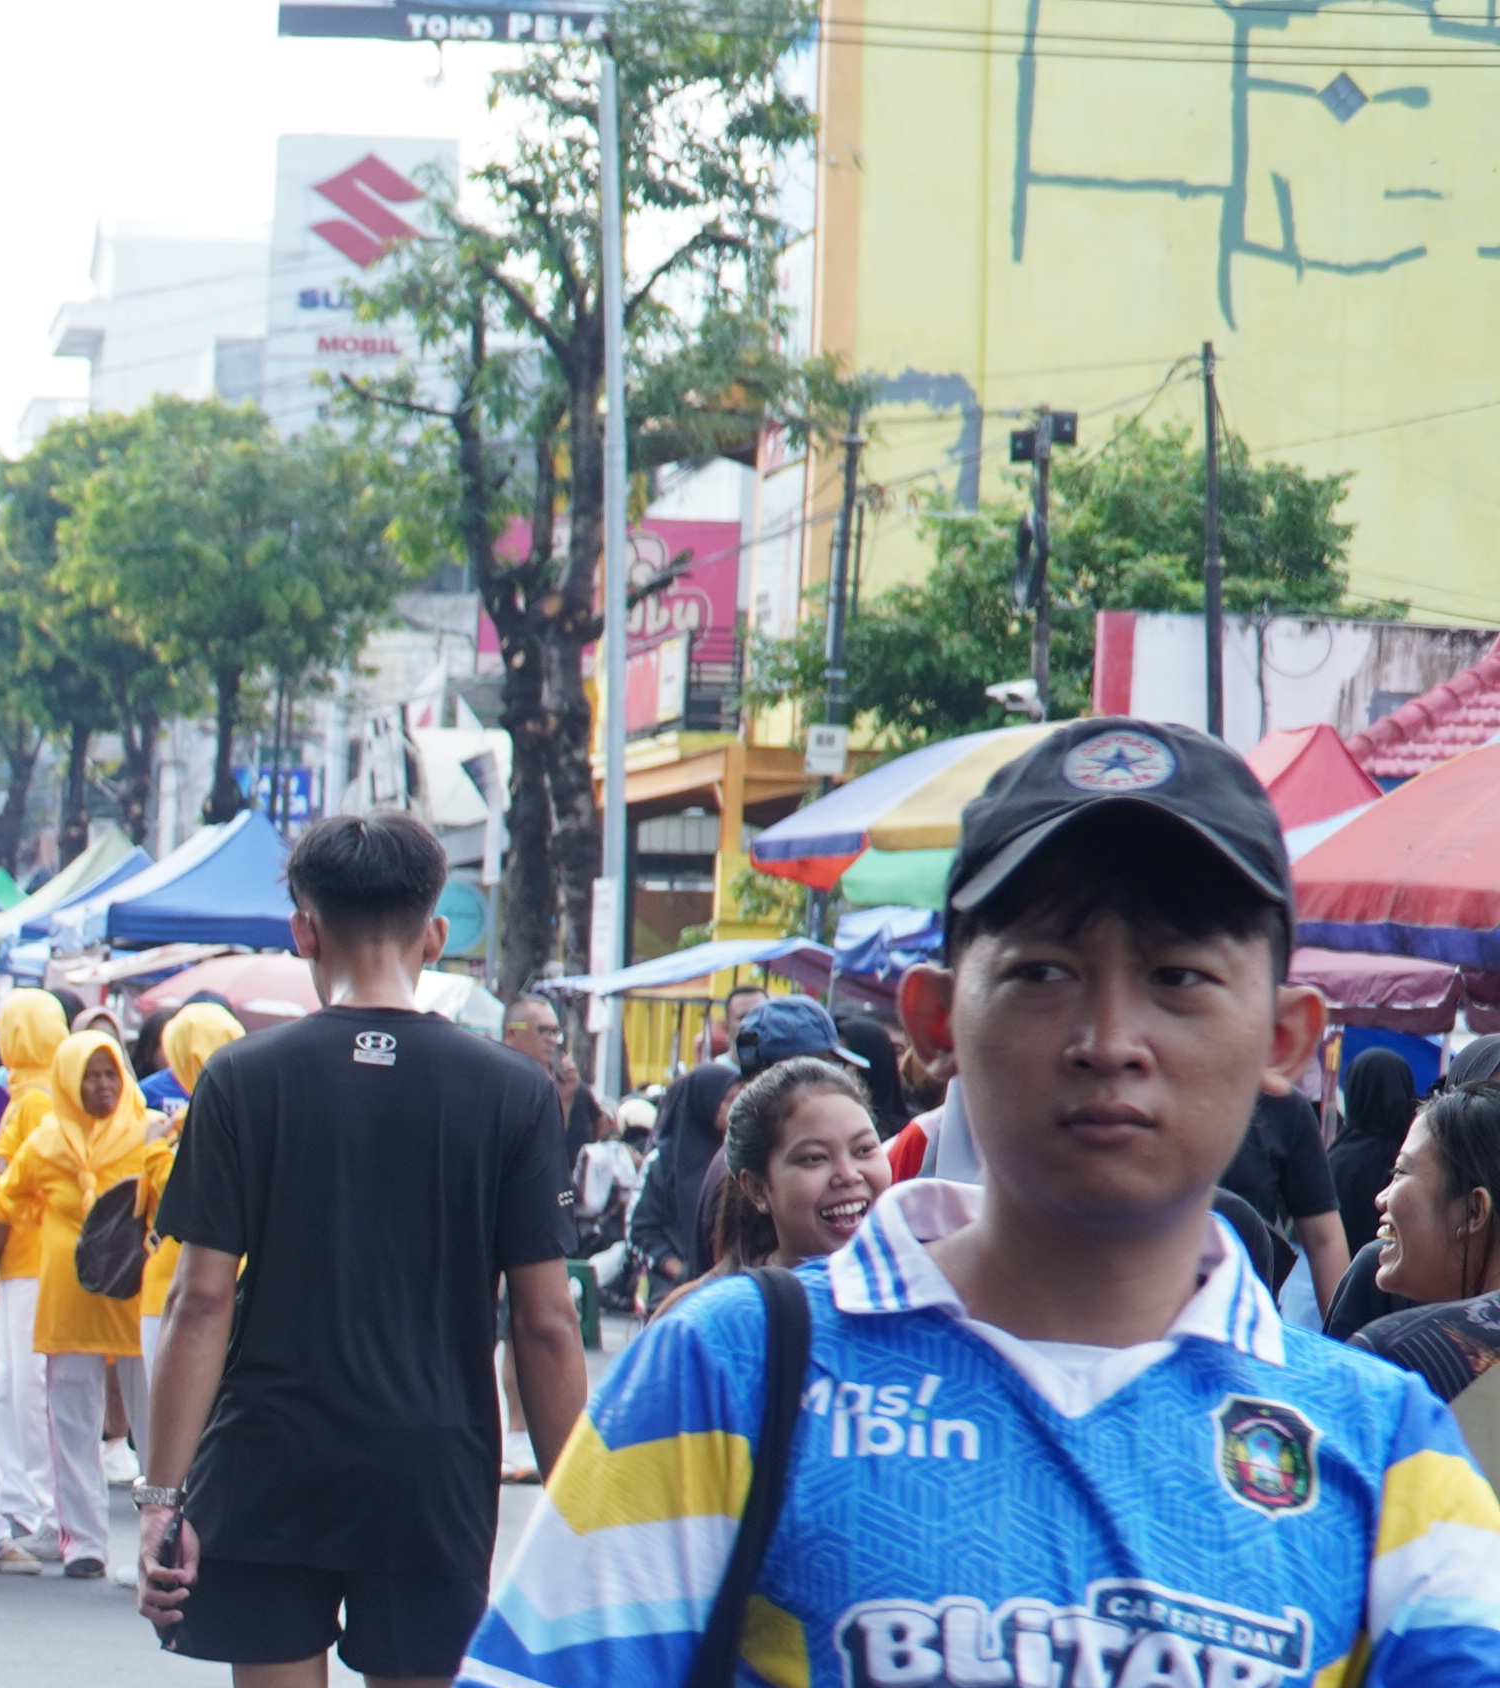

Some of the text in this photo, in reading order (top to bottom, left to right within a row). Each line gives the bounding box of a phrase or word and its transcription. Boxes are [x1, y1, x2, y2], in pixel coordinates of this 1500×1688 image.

[407, 14, 493, 40] TOKO
[317, 335, 402, 356] MOBIL
[1231, 1625, 1291, 1656] DAY
